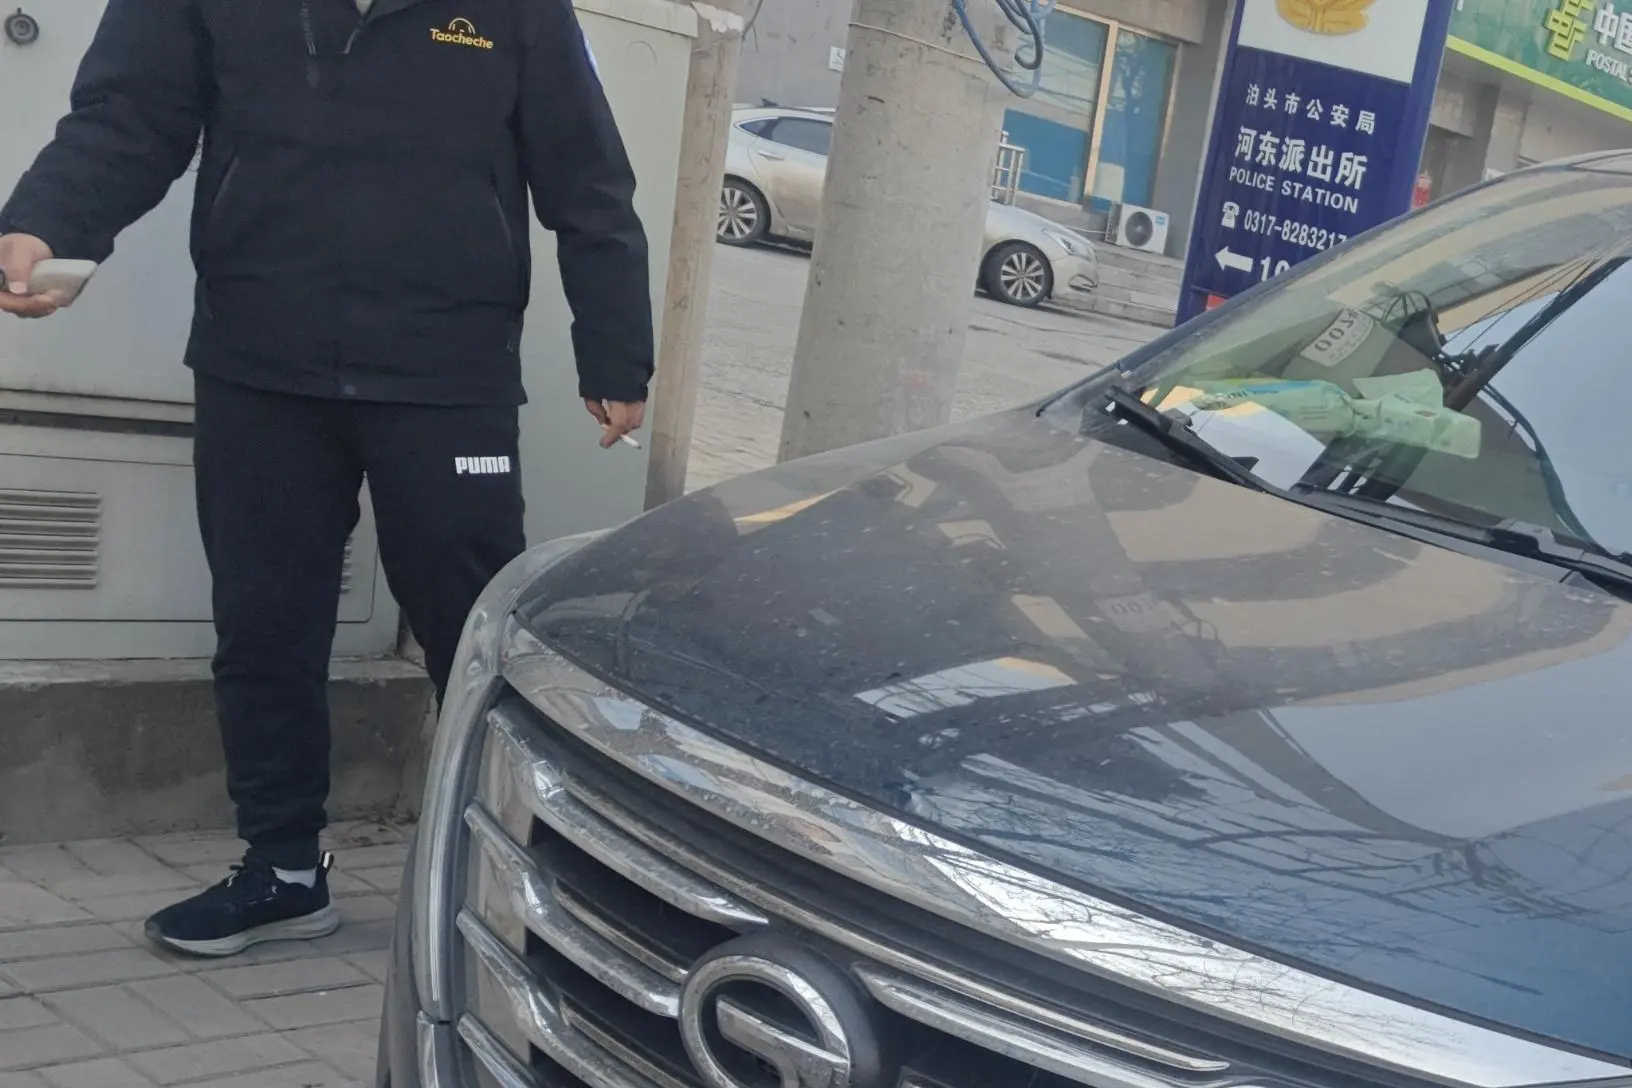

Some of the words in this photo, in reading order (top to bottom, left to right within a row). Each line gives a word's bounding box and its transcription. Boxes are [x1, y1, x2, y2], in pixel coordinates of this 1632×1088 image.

[430, 28, 494, 49] Taocheche
[1585, 49, 1628, 82] POSTAL
[1245, 84, 1376, 134] 泊头市公安局
[1234, 125, 1368, 190] 河东派出所
[1229, 166, 1275, 191] POLICE
[1281, 180, 1359, 214] STATION
[455, 456, 510, 474] PUMA
